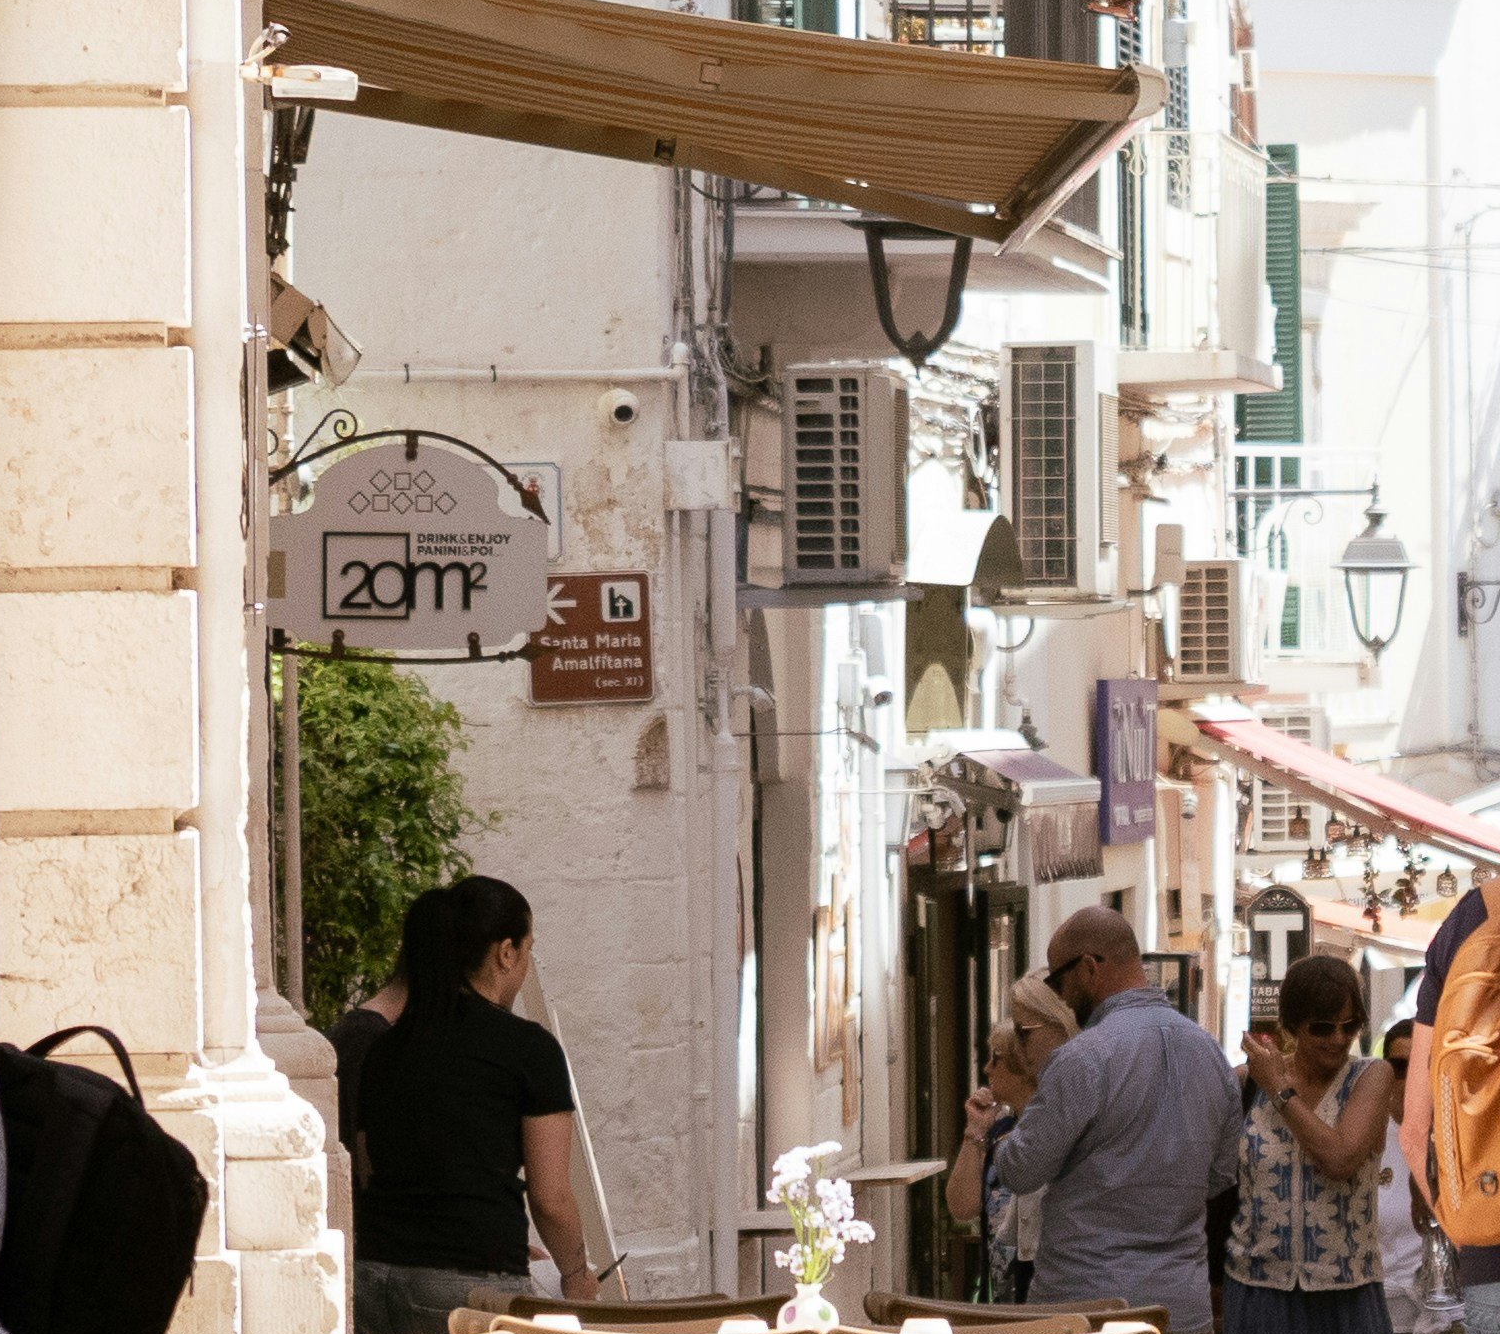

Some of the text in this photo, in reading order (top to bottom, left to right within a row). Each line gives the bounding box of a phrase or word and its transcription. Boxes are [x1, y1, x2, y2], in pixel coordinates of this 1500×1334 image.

[416, 533, 512, 545] DRINK&ENJOY
[539, 634, 642, 650] Santa Maria
[552, 654, 643, 672] Amalfitana
[1254, 913, 1303, 981] T
[1251, 986, 1281, 997] TABA
